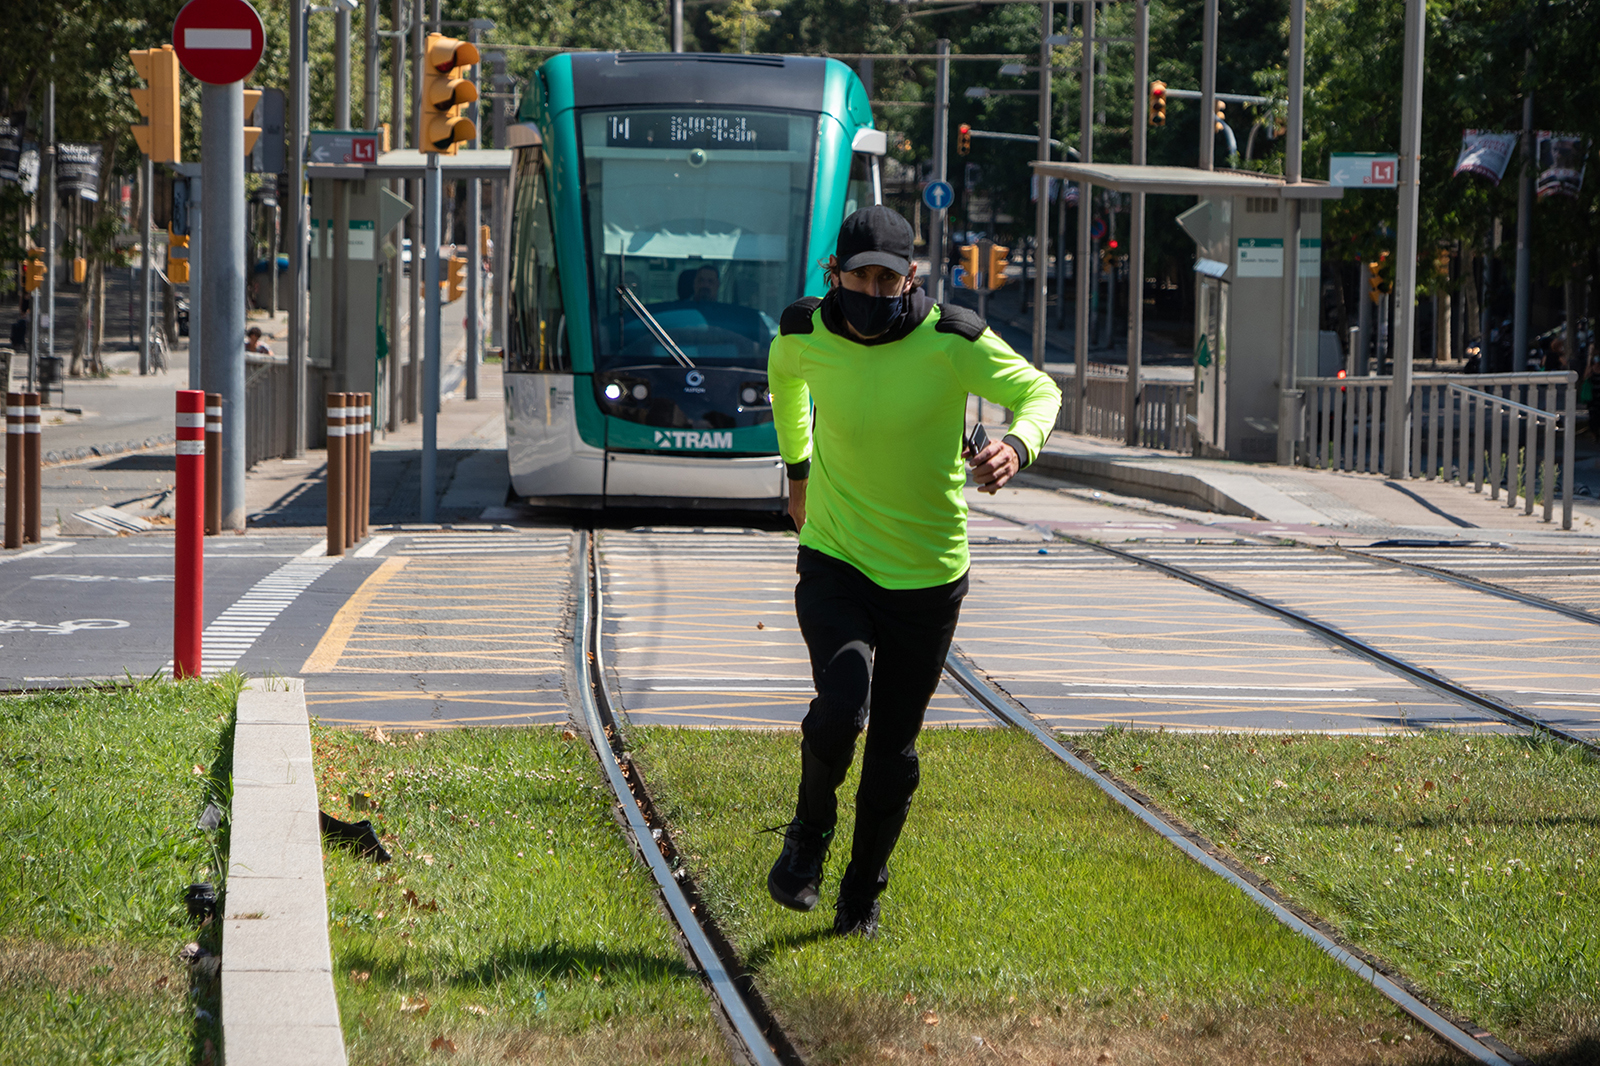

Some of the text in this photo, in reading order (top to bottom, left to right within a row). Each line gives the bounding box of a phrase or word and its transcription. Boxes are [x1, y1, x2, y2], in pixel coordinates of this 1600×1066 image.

[355, 143, 373, 159] L1
[1375, 165, 1391, 180] L1
[672, 431, 733, 449] TRAM
